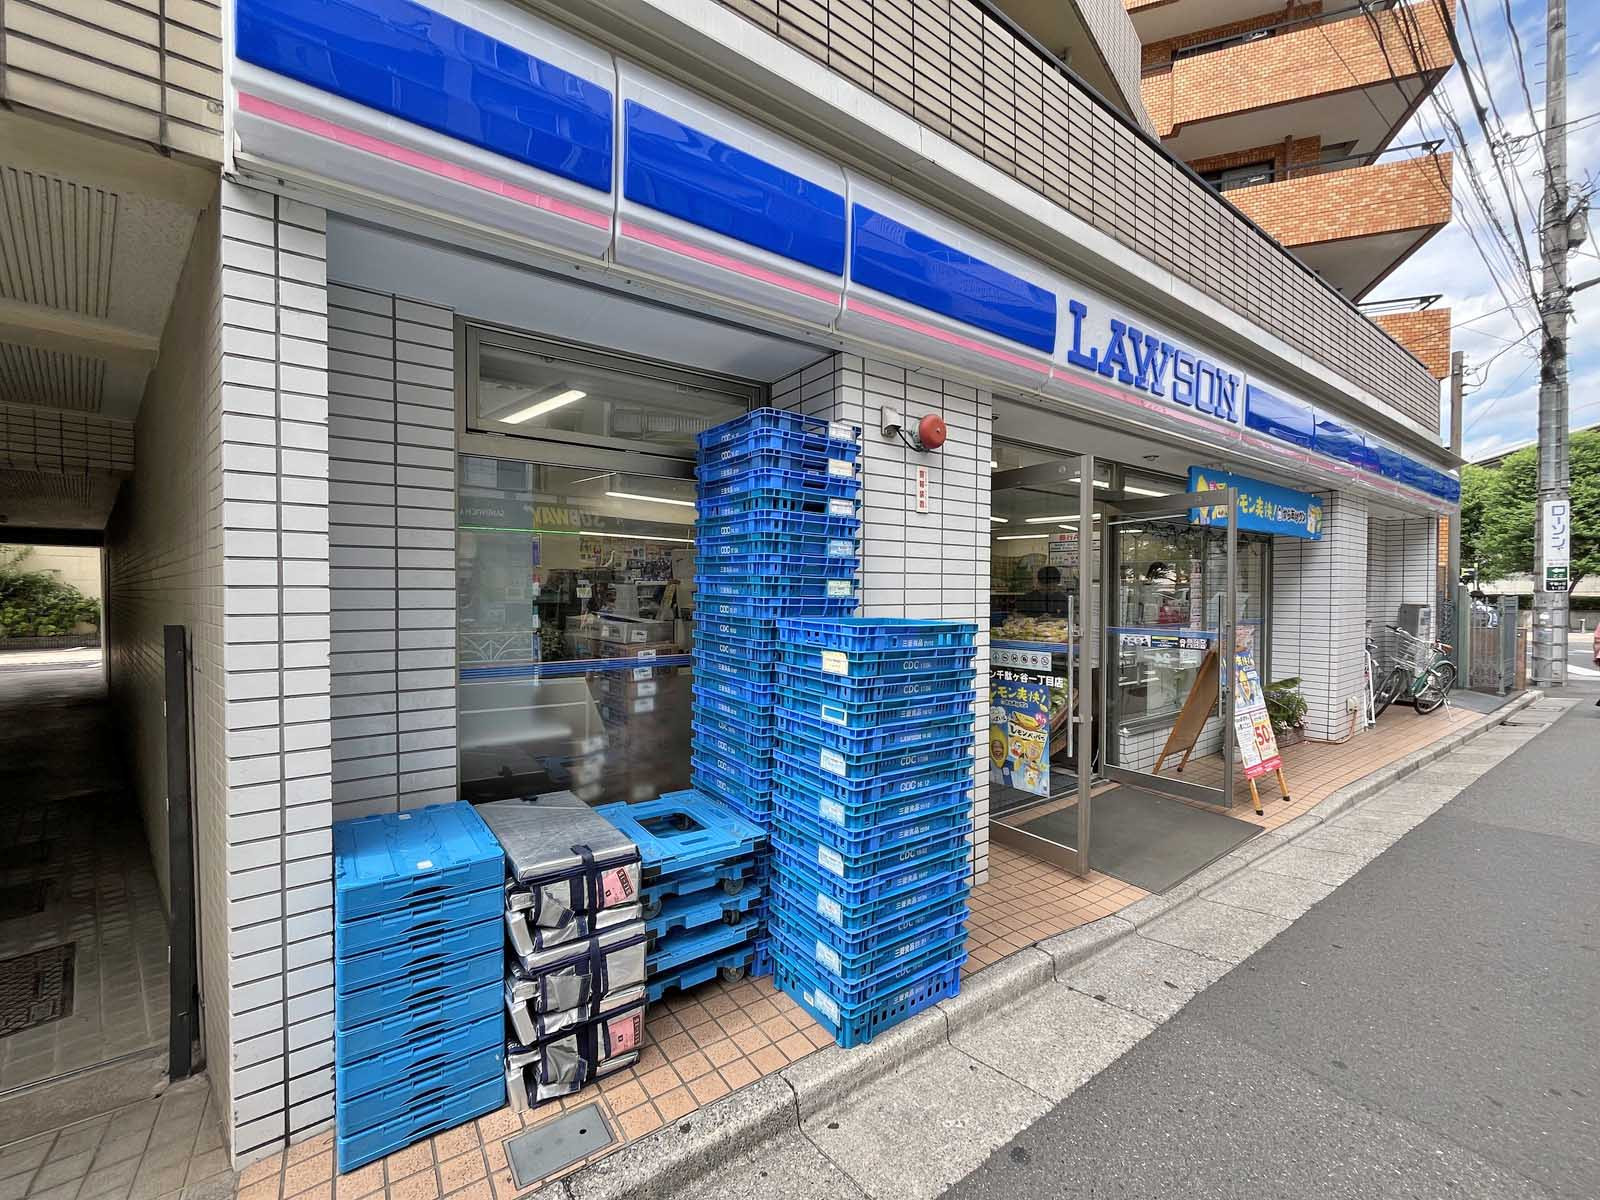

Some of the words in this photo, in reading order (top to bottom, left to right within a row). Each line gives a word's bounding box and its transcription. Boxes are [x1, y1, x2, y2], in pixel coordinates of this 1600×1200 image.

[1068, 299, 1240, 424] LAWSON
[1236, 493, 1277, 521] モン爽快!
[1551, 504, 1566, 550] ローソン
[903, 660, 920, 670] CDC
[903, 684, 920, 694] CDC
[900, 755, 916, 766] CDC
[900, 780, 916, 792] CDC
